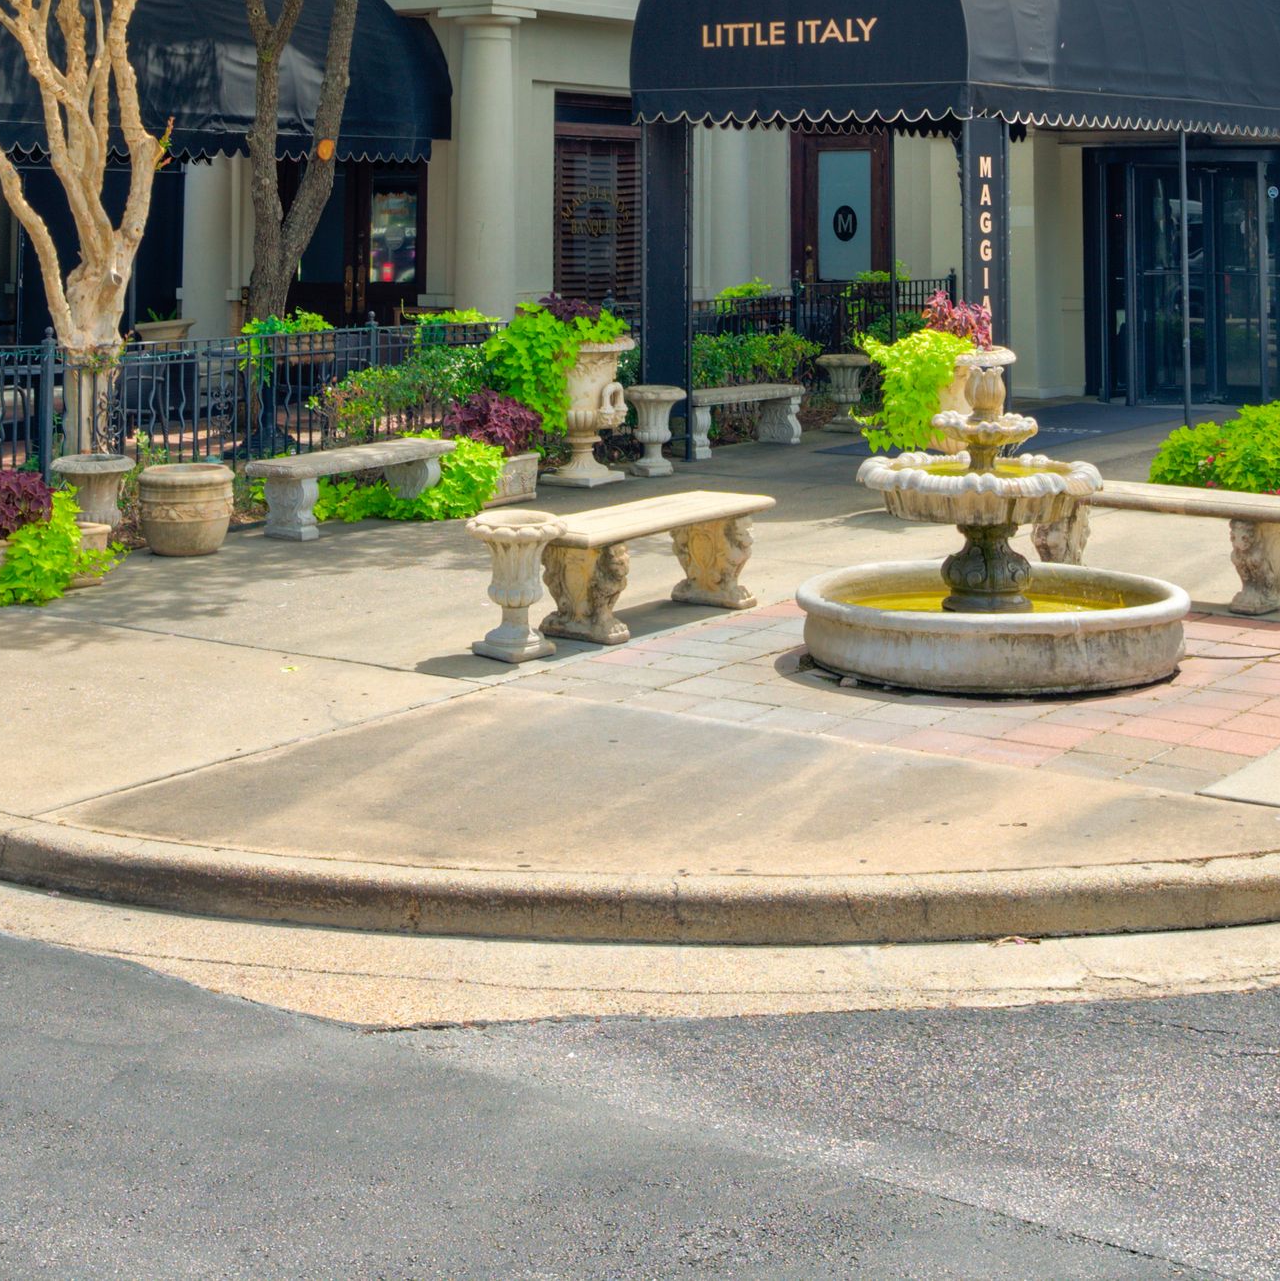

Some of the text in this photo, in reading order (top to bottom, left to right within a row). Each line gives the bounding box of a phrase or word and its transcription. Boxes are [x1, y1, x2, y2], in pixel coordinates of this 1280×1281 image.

[701, 17, 878, 48] LITTLE ITALY
[837, 213, 853, 234] M
